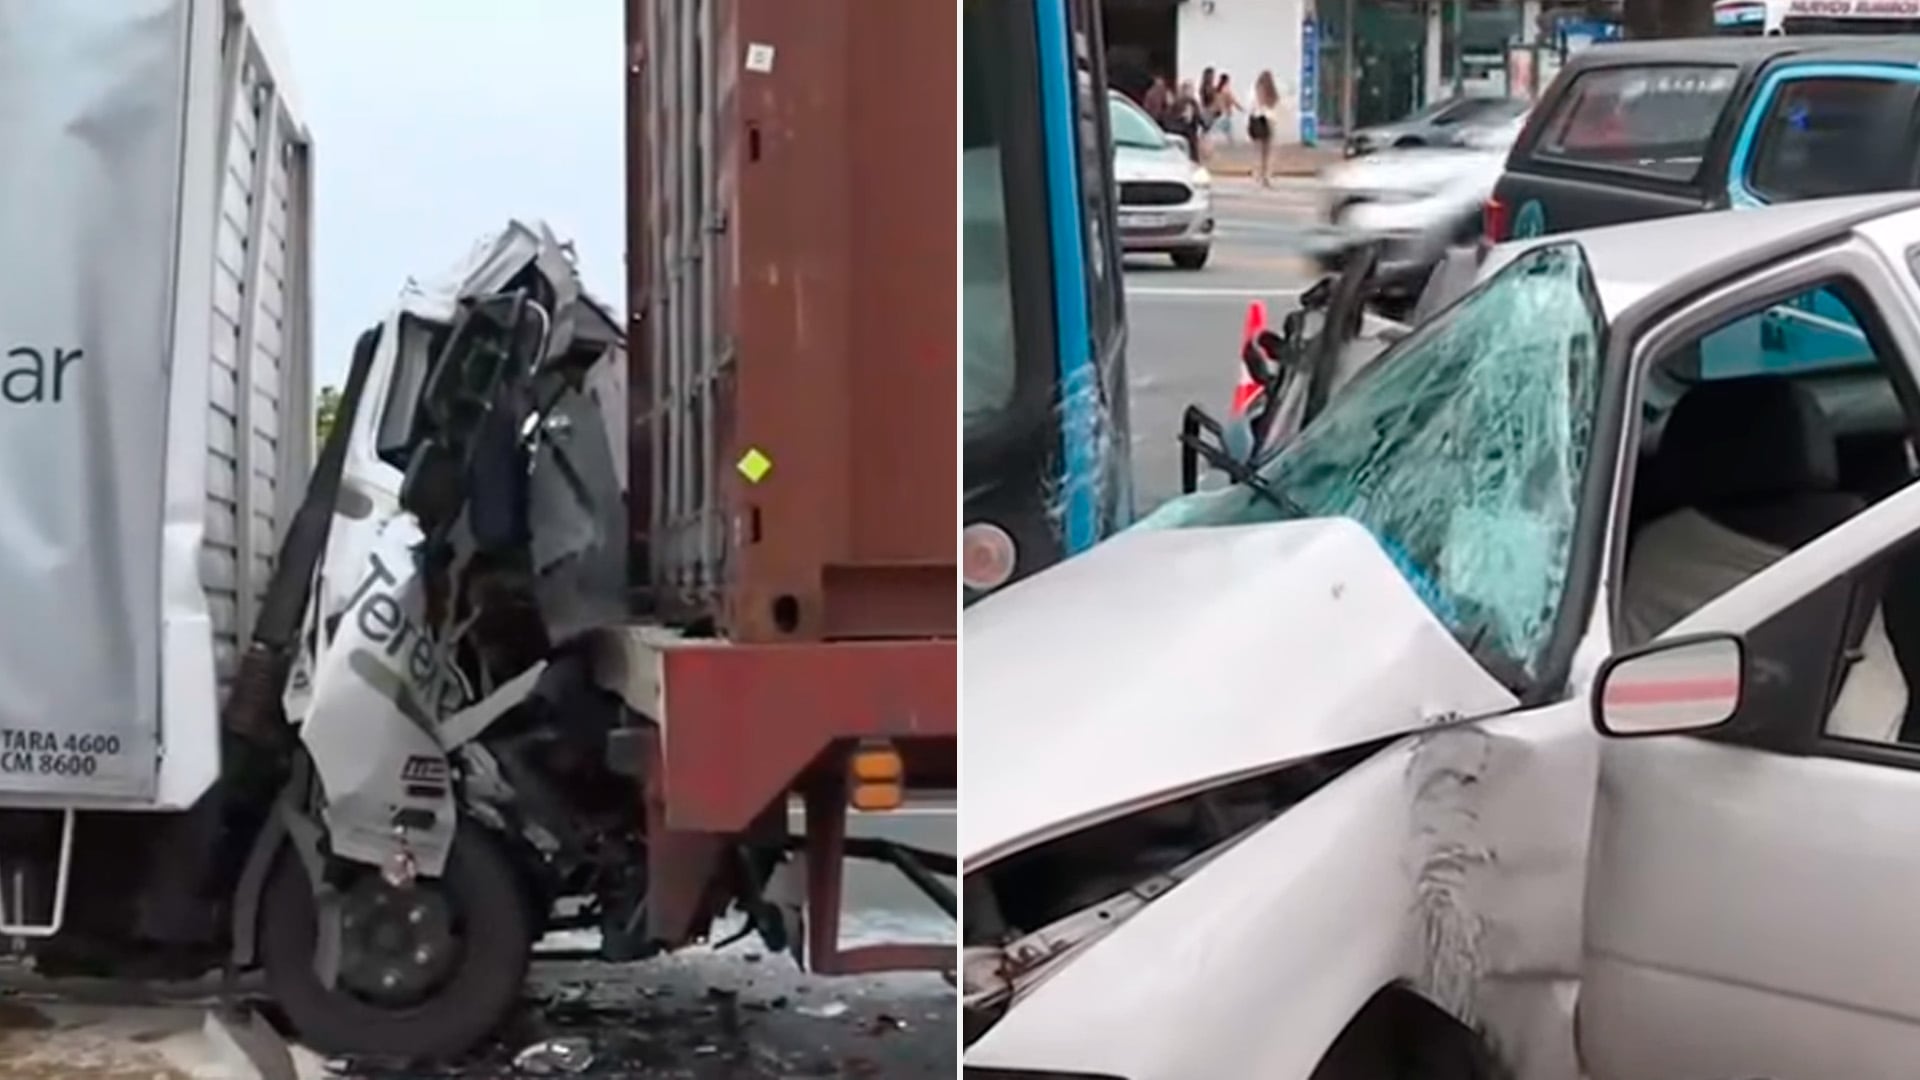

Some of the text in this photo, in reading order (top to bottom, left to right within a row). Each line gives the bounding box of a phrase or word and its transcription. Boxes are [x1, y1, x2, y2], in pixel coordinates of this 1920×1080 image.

[1, 729, 121, 755] TARA 4600
[0, 752, 98, 776] CM 8600
